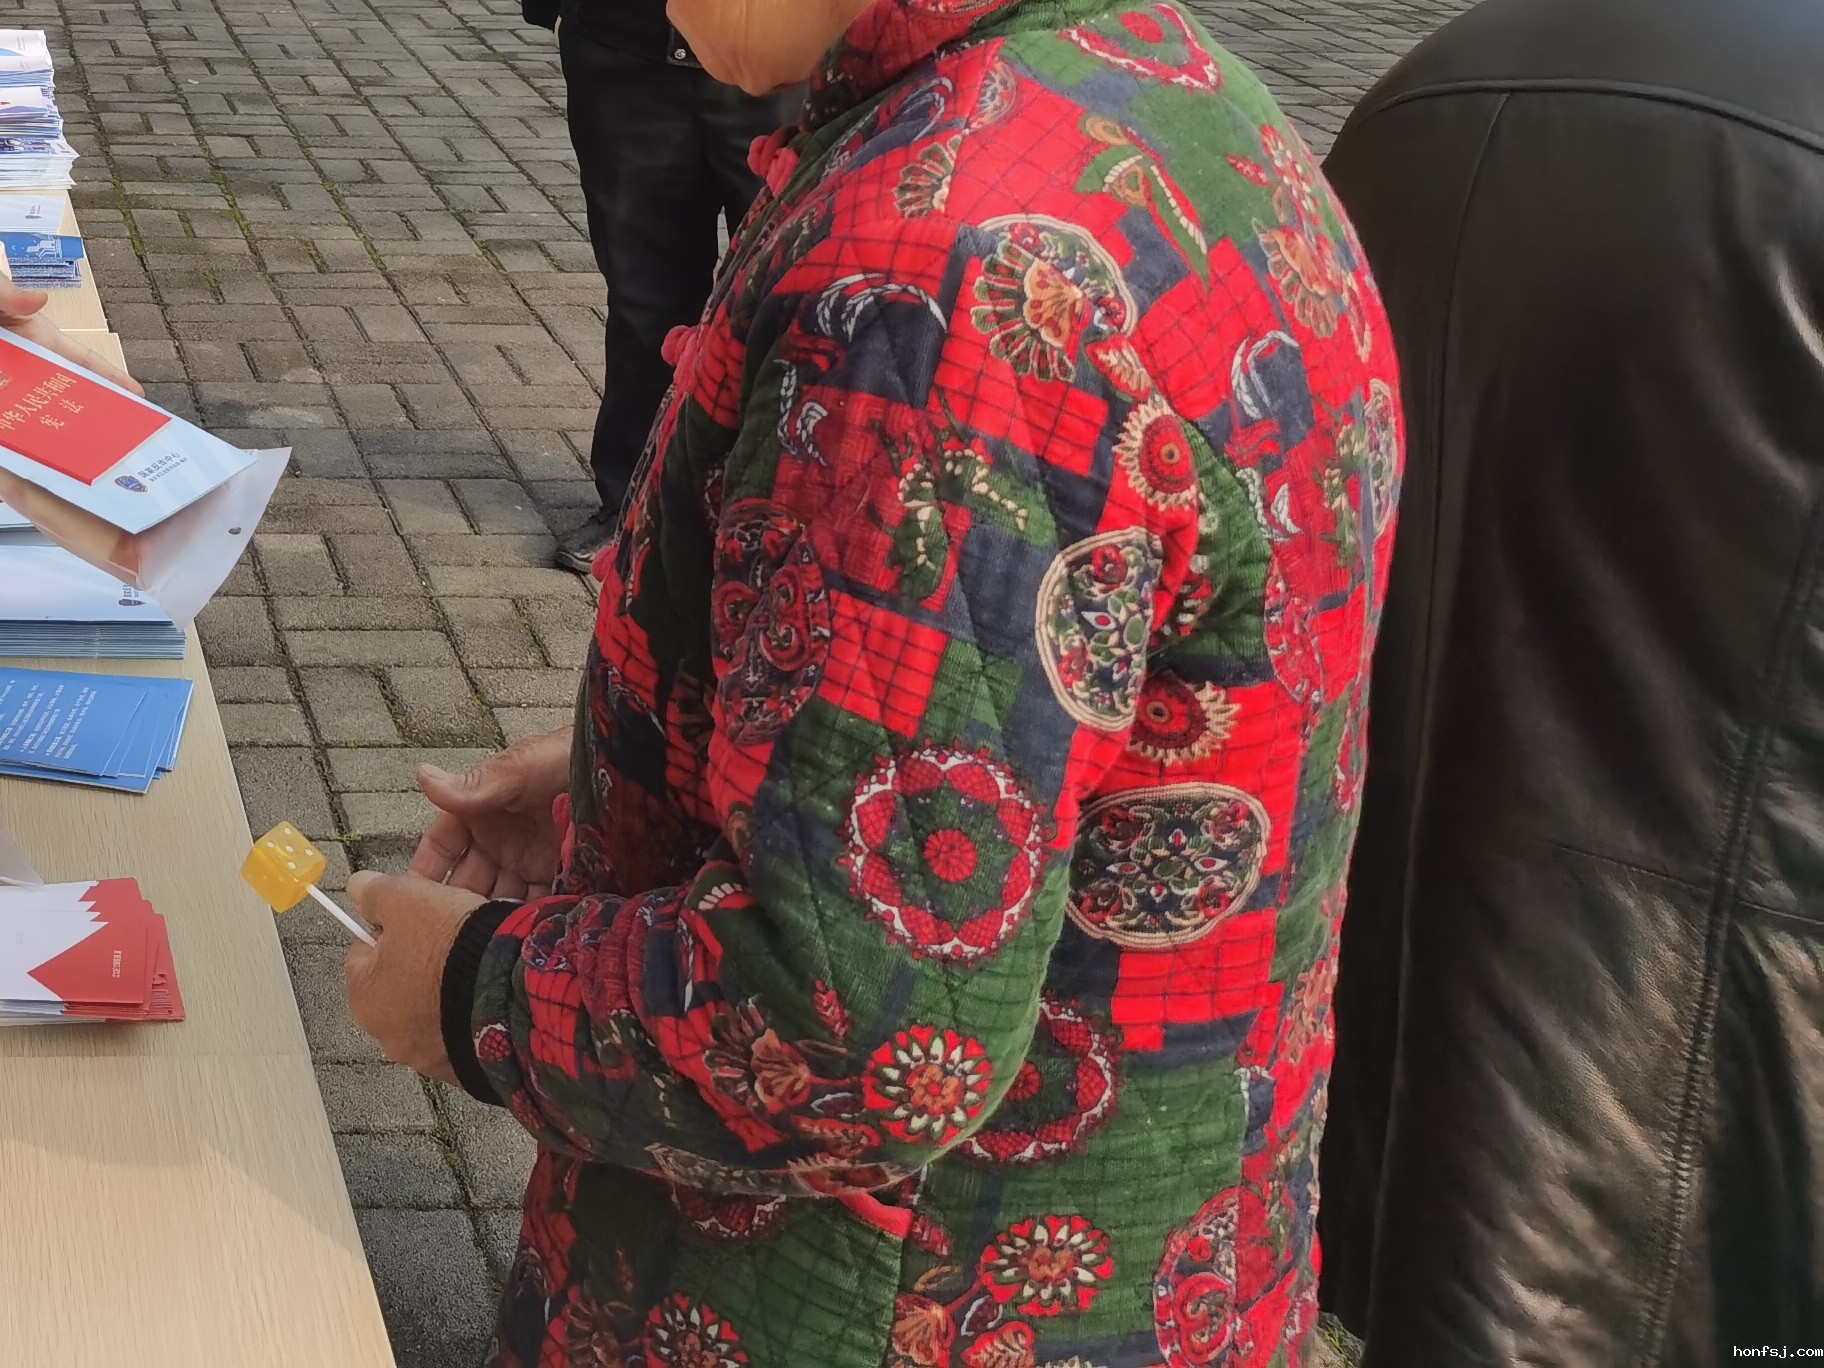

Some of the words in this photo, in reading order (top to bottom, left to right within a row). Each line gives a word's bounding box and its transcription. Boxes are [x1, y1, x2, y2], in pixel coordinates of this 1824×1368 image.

[39, 399, 85, 432] 宪法
[137, 451, 181, 480] 国家反诈中心
